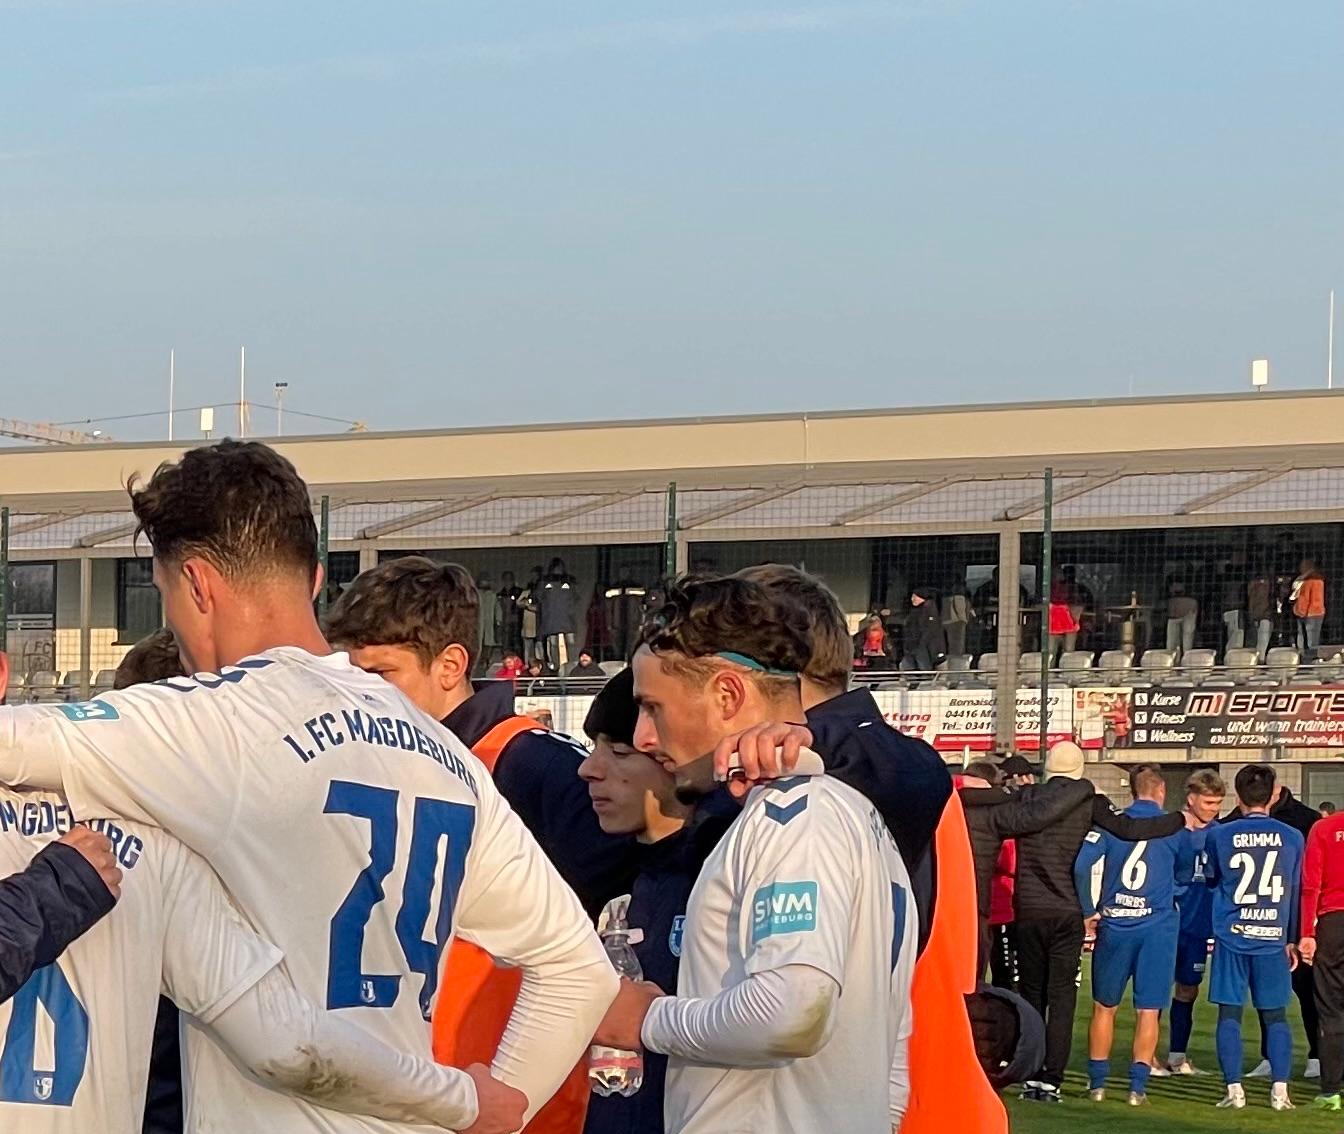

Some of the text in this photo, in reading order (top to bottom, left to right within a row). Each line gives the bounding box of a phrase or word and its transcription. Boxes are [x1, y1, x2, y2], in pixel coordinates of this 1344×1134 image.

[1150, 692, 1182, 706] Kurse
[1150, 711, 1187, 724] Fitness
[1226, 717, 1255, 733] und
[1255, 719, 1292, 733] wann
[1150, 729, 1195, 743] Wellness
[1233, 832, 1283, 848] GRIMMA
[1120, 840, 1148, 891] 6
[1229, 850, 1285, 905] 24
[1240, 907, 1279, 921] NAKANO
